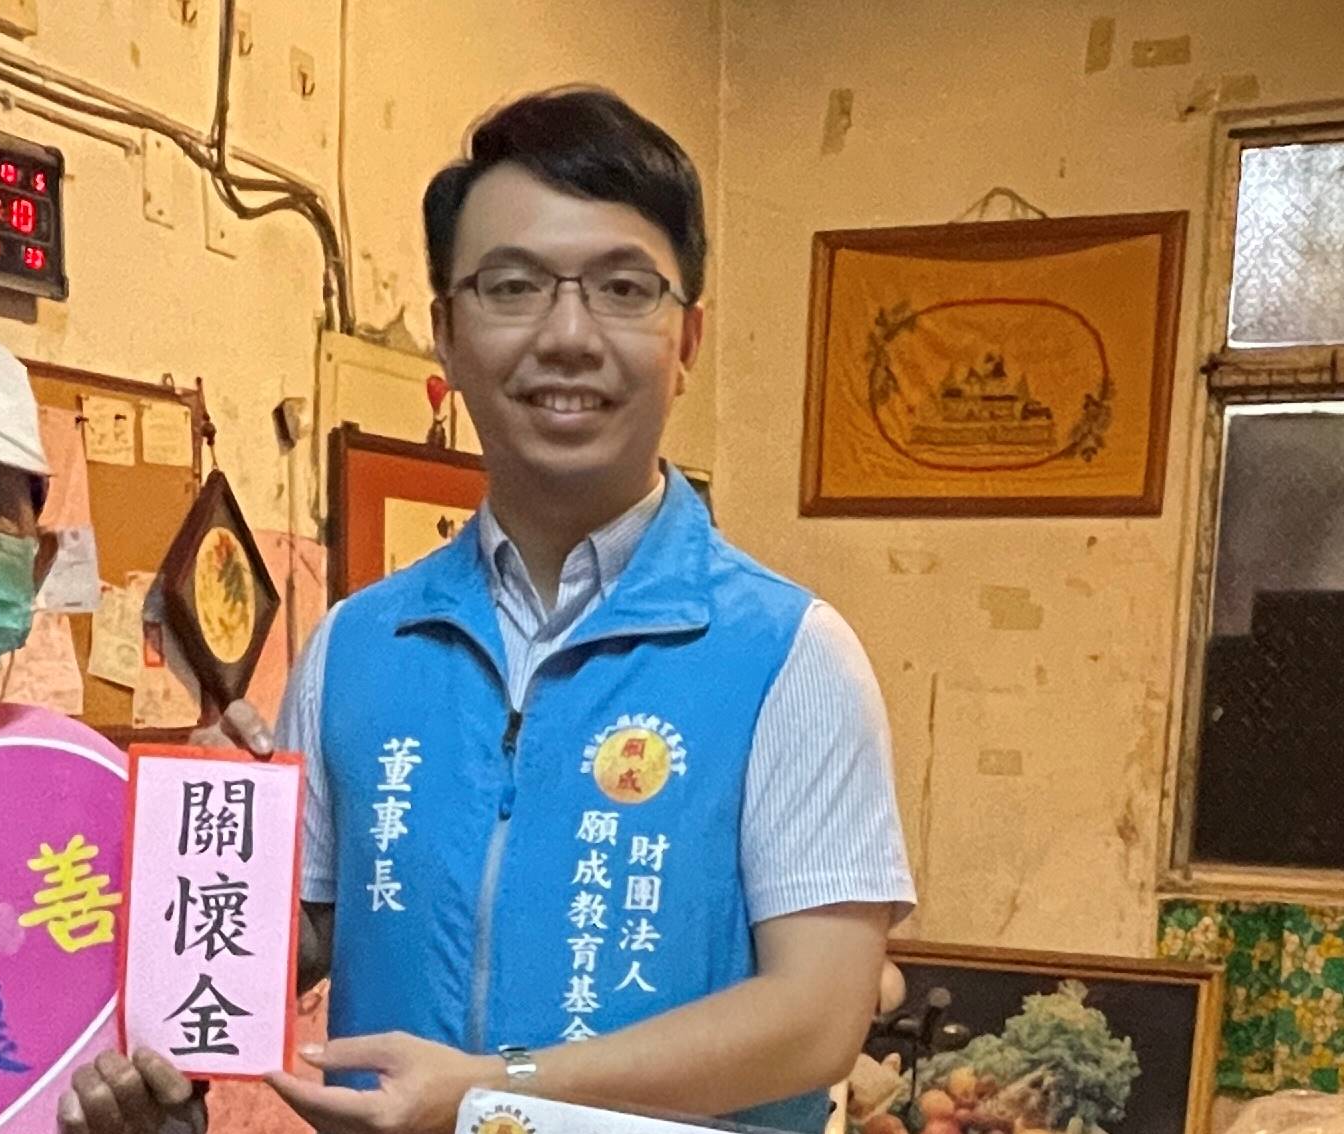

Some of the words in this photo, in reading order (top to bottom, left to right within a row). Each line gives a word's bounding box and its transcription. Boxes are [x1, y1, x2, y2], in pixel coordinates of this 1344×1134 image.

[163, 779, 256, 1057] 關懷金
[366, 737, 422, 912] 董事長
[560, 810, 621, 1042] 願成教育基金
[614, 834, 670, 993] 財團法人
